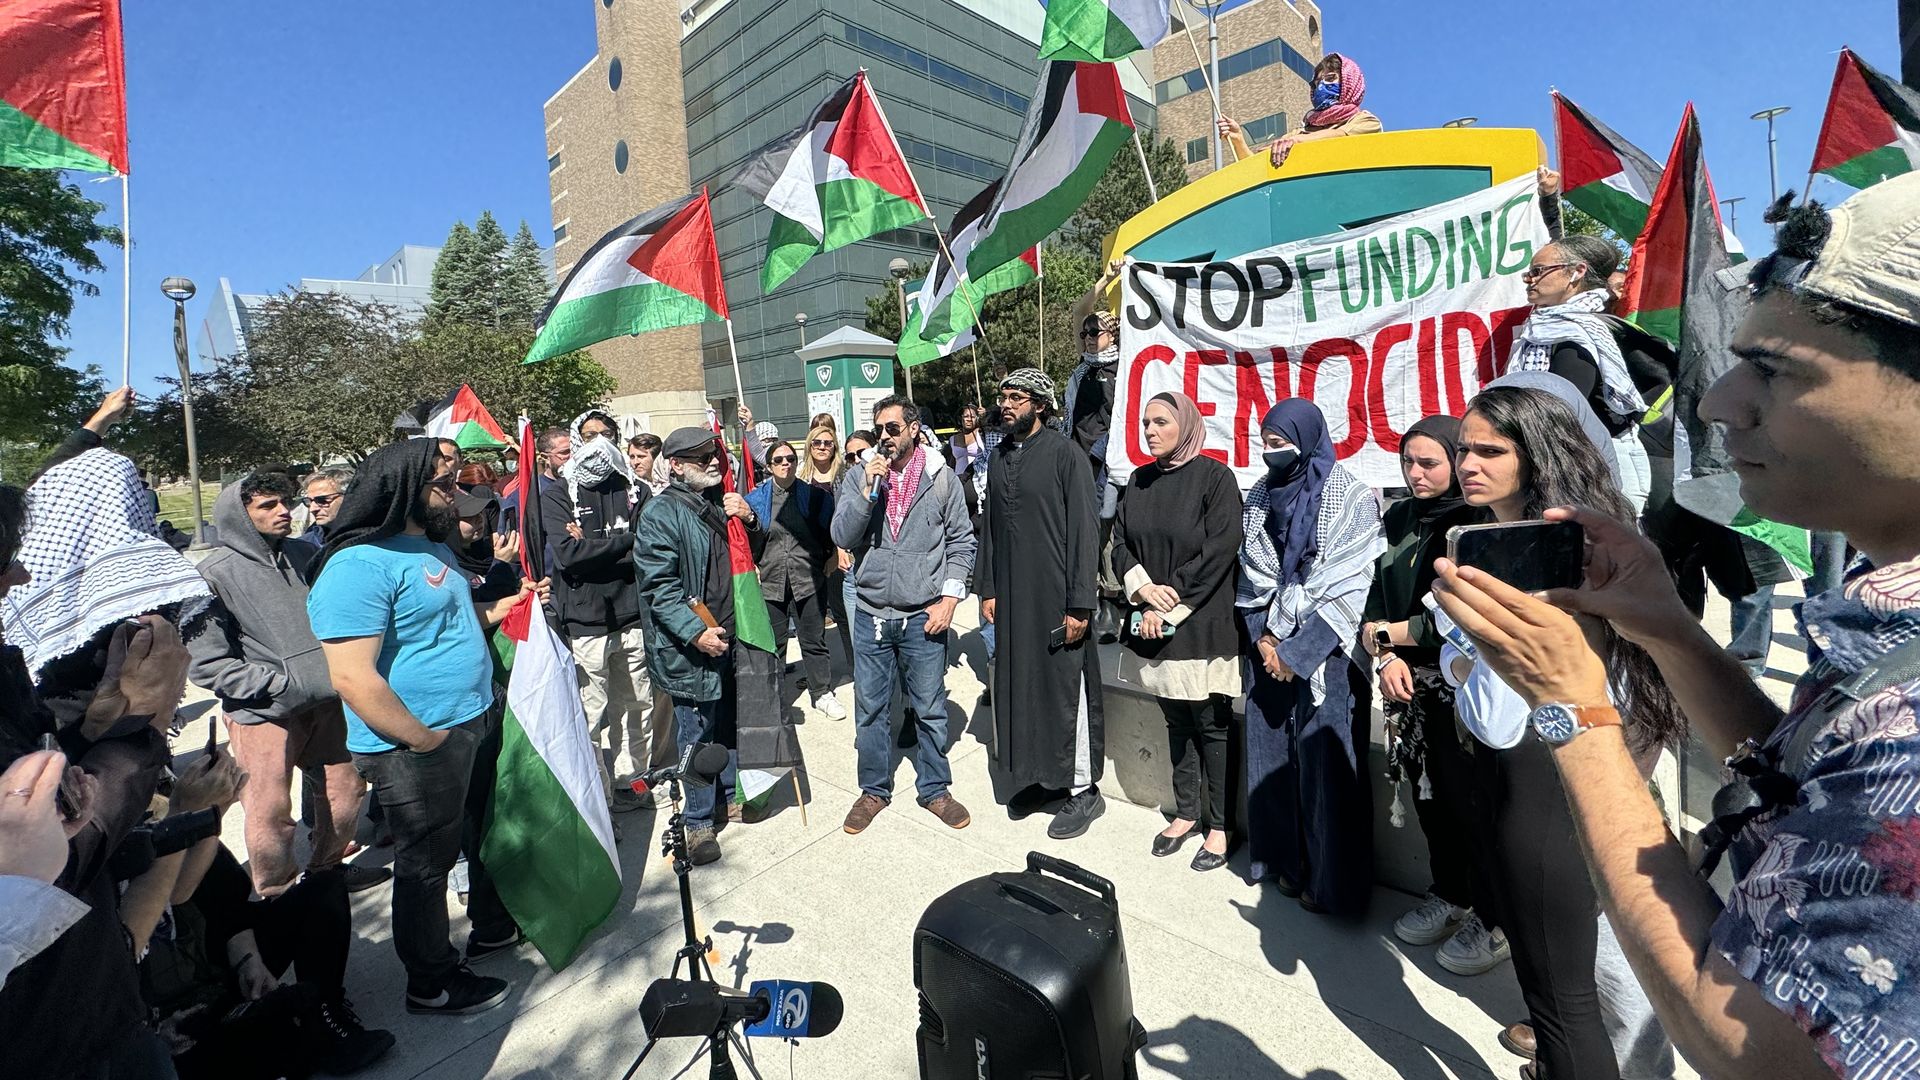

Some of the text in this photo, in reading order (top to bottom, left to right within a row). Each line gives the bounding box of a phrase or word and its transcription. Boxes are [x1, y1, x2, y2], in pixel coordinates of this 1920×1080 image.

[1126, 193, 1534, 332] STOP FUNDING
[775, 989, 784, 1026] WXYZ.COM
[975, 1038, 986, 1080] PYL
